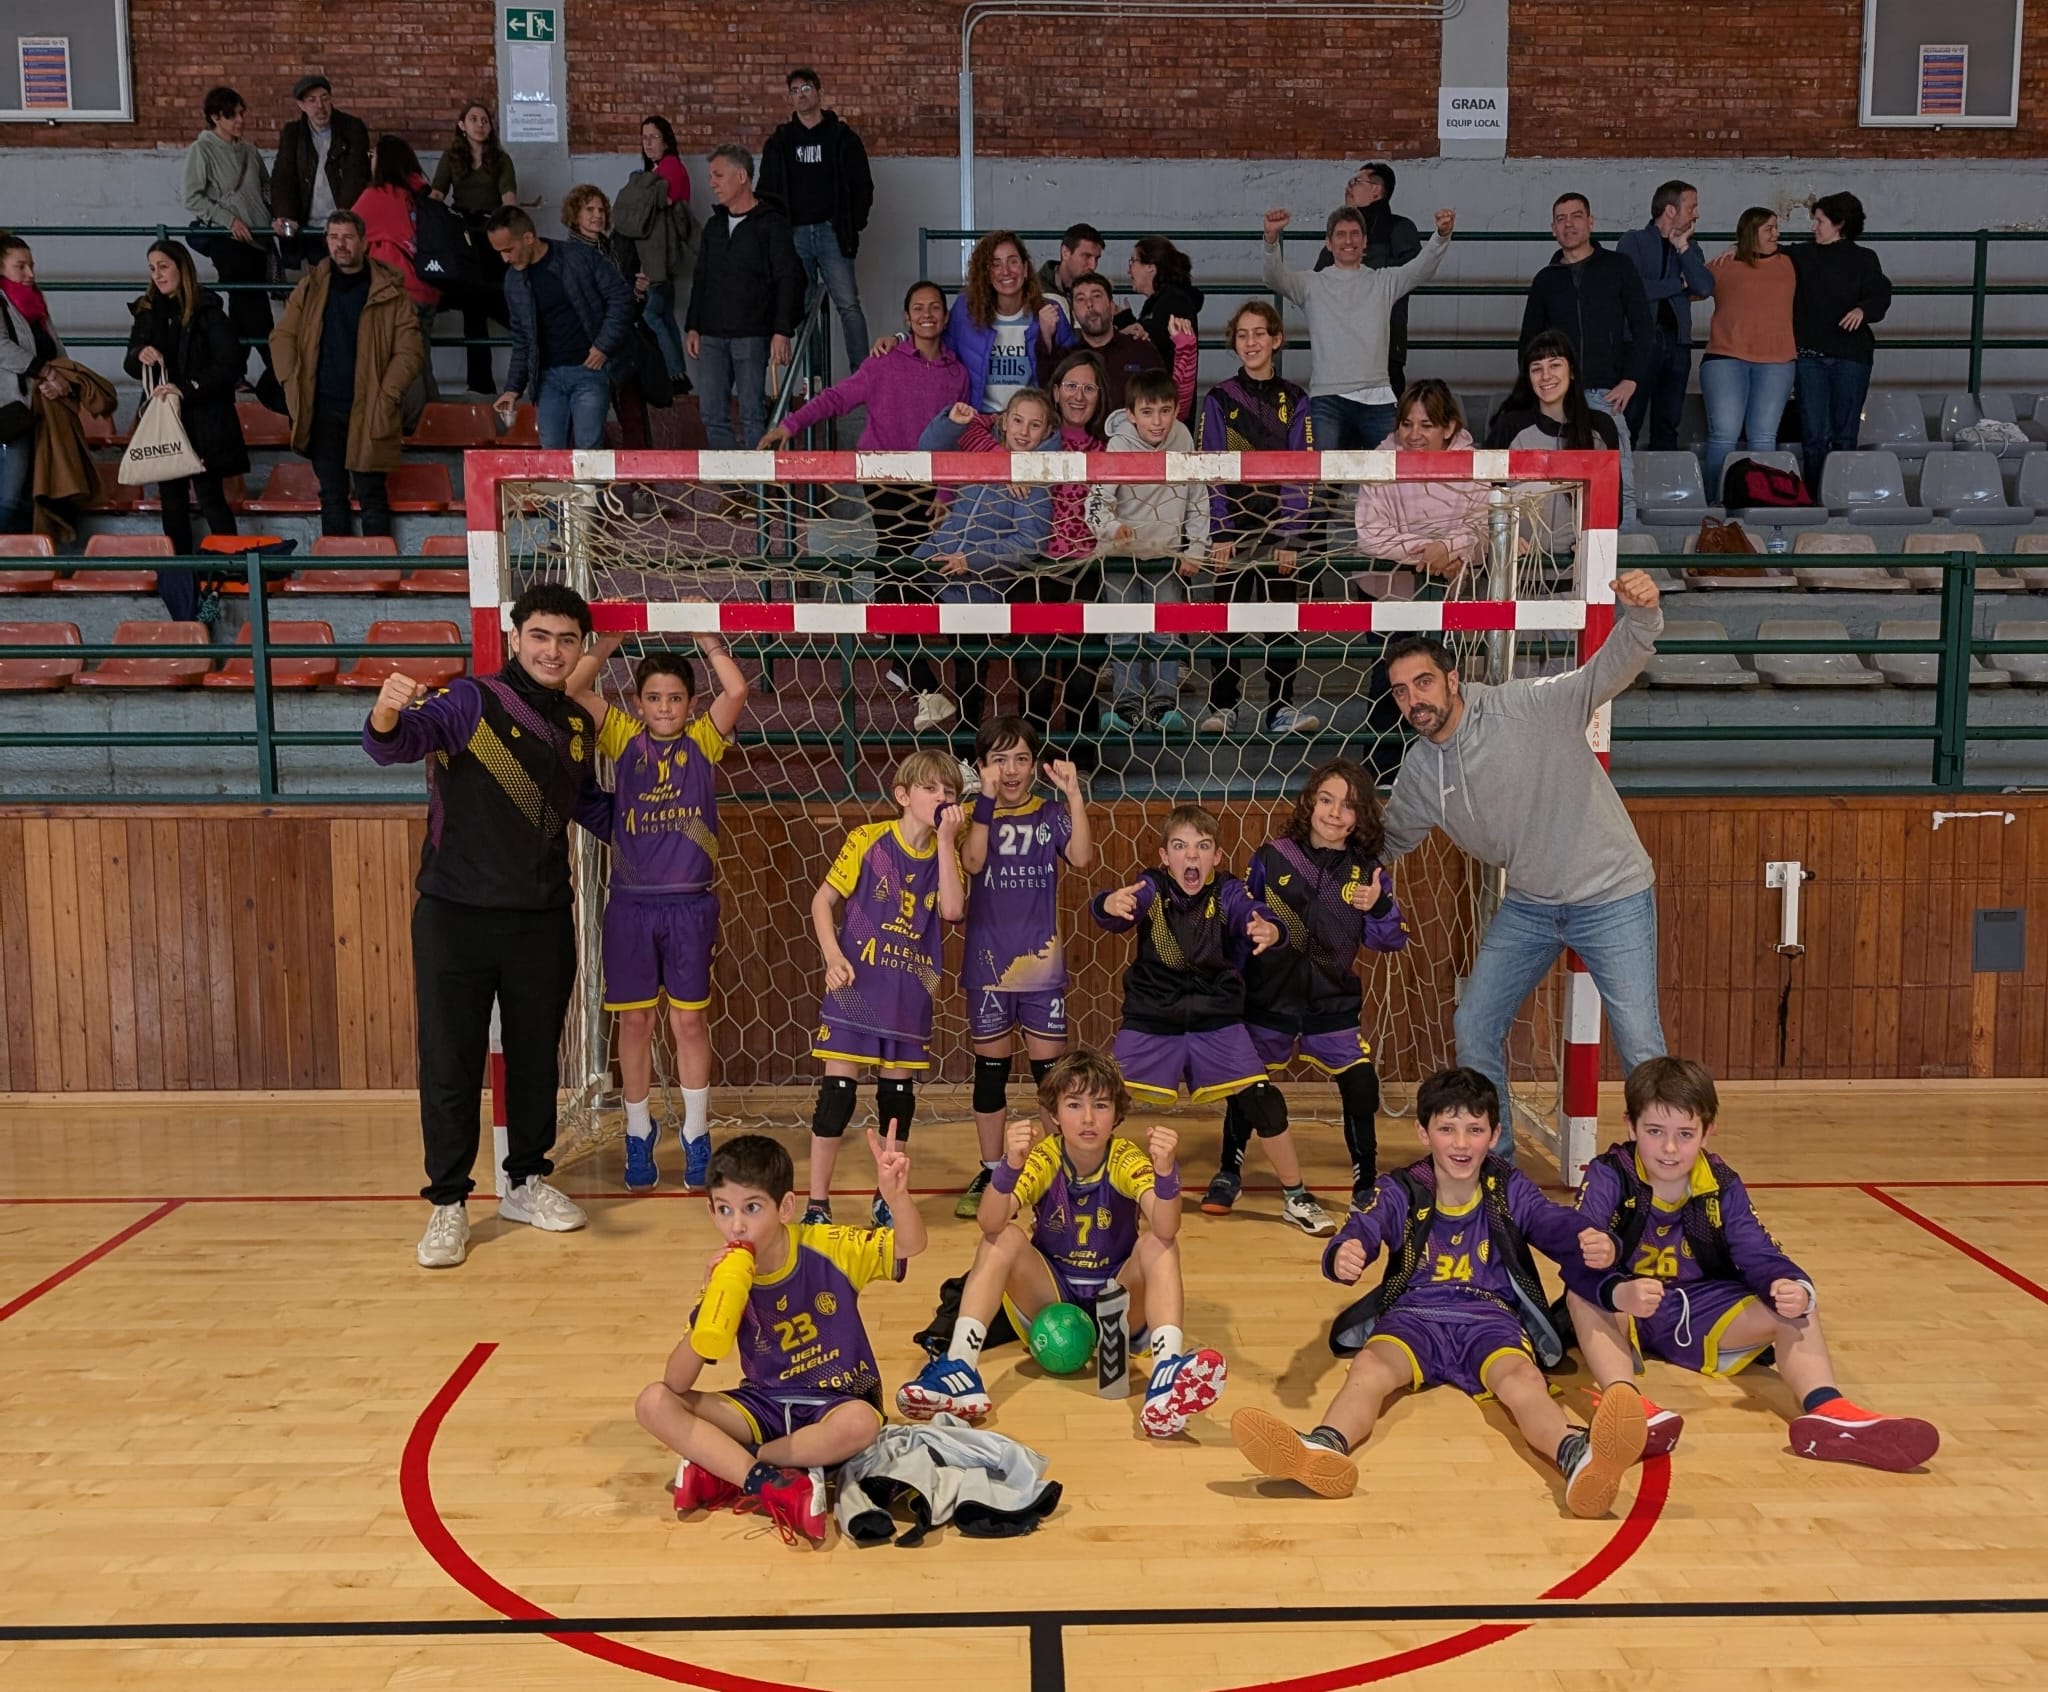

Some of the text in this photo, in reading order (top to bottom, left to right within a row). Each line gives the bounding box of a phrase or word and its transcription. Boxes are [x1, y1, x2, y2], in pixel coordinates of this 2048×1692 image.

[1451, 98, 1496, 110] GRADA
[1446, 119, 1500, 128] EQUIP LOCAL
[990, 344, 1026, 357] ever
[989, 358, 1025, 376] Hills
[144, 441, 182, 457] BNEW
[642, 806, 702, 822] ALEGRIA
[999, 823, 1034, 855] 27
[1000, 863, 1054, 877] ALEGRIA
[1000, 879, 1047, 889] HOTELS
[1075, 1214, 1093, 1246] 7
[1069, 1250, 1097, 1258] UEH
[1633, 1243, 1679, 1277] 26
[1431, 1253, 1473, 1283] 34
[773, 1312, 818, 1352] 23
[791, 1343, 822, 1364] UEH
[780, 1348, 840, 1380] CALELLA
[818, 1360, 869, 1388] EGRIA
